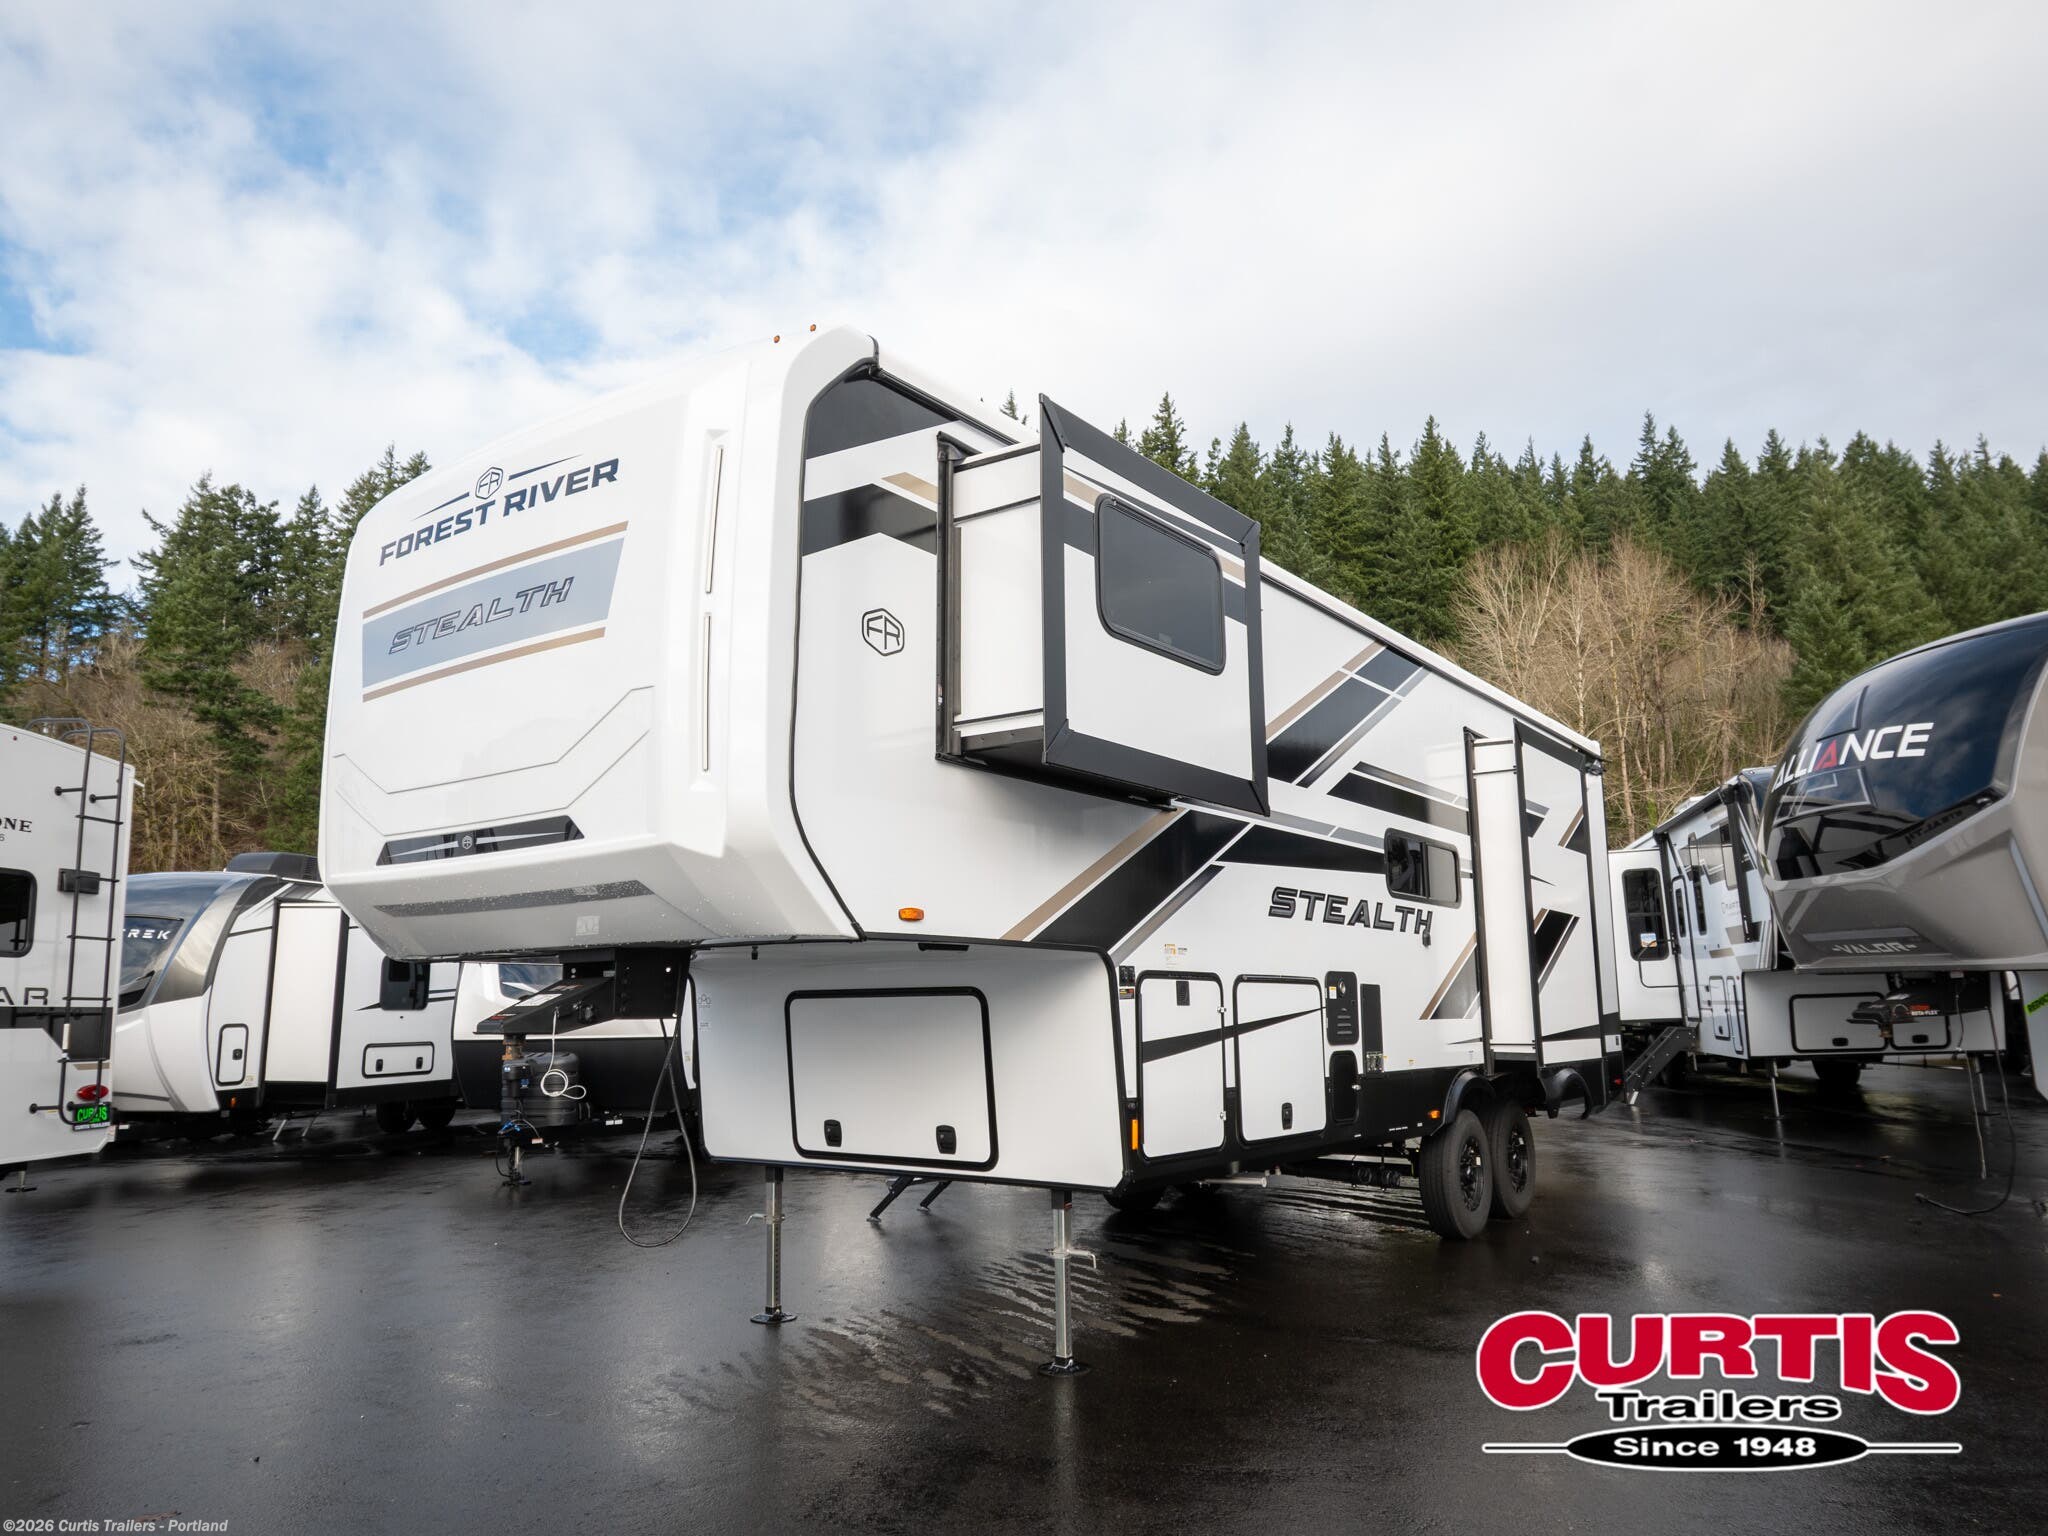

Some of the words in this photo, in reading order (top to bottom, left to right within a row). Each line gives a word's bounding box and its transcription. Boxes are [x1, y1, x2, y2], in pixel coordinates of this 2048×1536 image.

[379, 500, 496, 567] FOREST
[503, 458, 619, 518] RIVER
[388, 576, 575, 655] STEALTH
[1771, 722, 1935, 793] ALLIANCE
[0, 817, 33, 833] NE
[122, 928, 171, 940] REK
[1268, 886, 1433, 935] STEALTH
